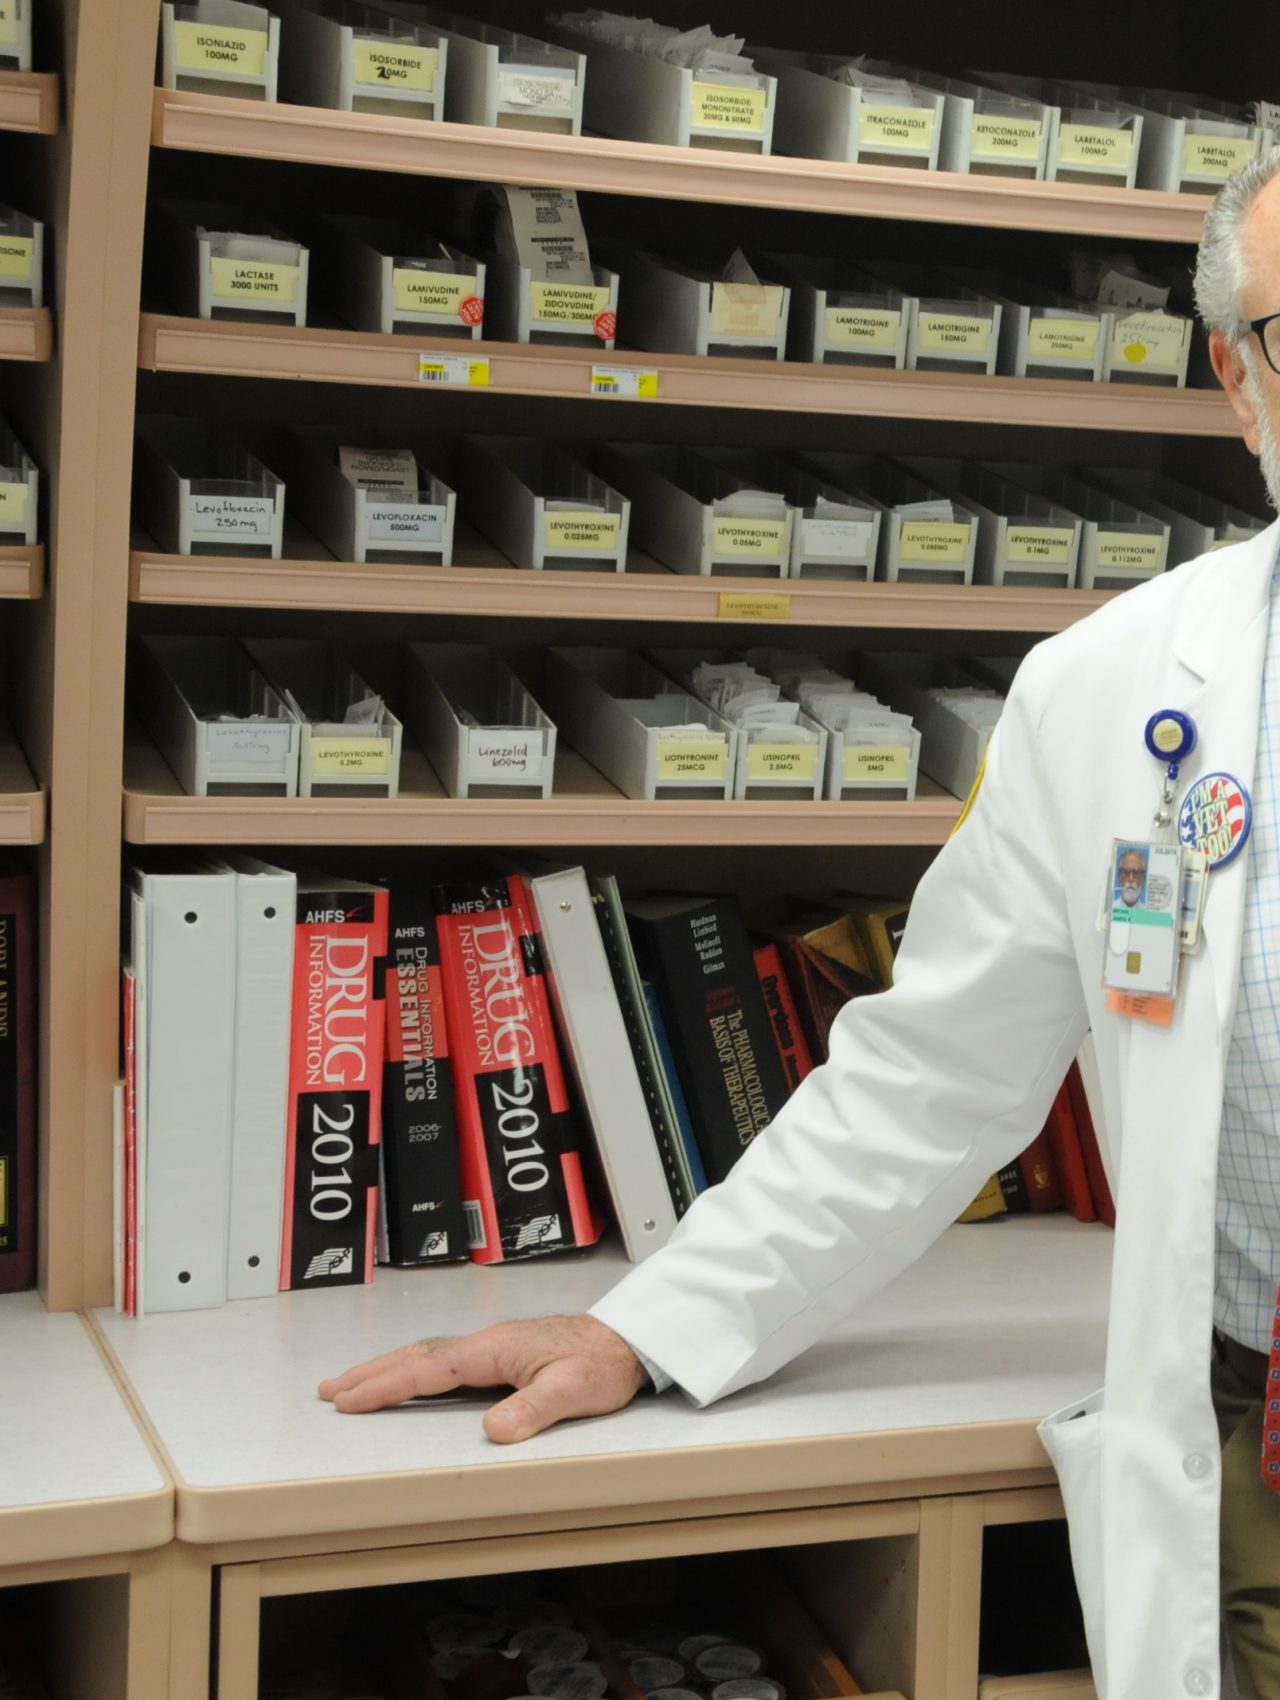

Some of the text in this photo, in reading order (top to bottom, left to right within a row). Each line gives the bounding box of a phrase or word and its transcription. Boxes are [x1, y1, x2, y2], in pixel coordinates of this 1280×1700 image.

[197, 37, 246, 51] ISONIAZID
[204, 50, 239, 62] 100MG
[369, 54, 422, 70] ISOSORBIDE
[706, 95, 751, 106] ISOSORBIDE
[701, 103, 755, 116] MONONITRATE
[866, 115, 926, 129] ITRACONAZOLE
[882, 127, 909, 138] 100MG
[976, 125, 1036, 139] KETOCONAZOLE
[992, 136, 1019, 147] 200MG
[1074, 135, 1115, 147] LABETALOL
[1081, 146, 1107, 156] 100MG
[1197, 146, 1235, 158] LABETALOL
[1202, 157, 1228, 167] 200MG
[235, 269, 275, 281] LACTASE
[230, 280, 279, 292] 3000 UNITS
[407, 284, 460, 296] LAMIVUDINE
[418, 296, 449, 306] 150MG
[542, 289, 597, 301] LAMIVUDINE/
[544, 299, 595, 311] ZIDOVUDINE
[835, 316, 889, 329] LAMOTRIGINE
[928, 323, 980, 334] LAMOTRIGINE
[848, 328, 875, 337] 100MG
[940, 333, 967, 343] 150MG
[1039, 333, 1086, 343] LAMOTRIGINE
[195, 502, 266, 515] Levofloxacin
[372, 512, 437, 522] LEVOFLOXACIN
[390, 523, 420, 532] 500MG
[550, 521, 614, 533] LEVOTHYROXINE
[564, 532, 600, 542] 0.025MG
[717, 528, 779, 539] LEVOTHYROXINE
[907, 535, 963, 544] LEVOTHYROXINE
[732, 538, 762, 547] 0.05MG
[1011, 536, 1068, 547] LEVOTHYROXINE
[1100, 545, 1156, 555] LEVOTHYROXINE
[319, 751, 384, 759] LEVOTHYROXINE
[478, 743, 528, 757] Linezolid
[664, 753, 719, 762] LIOTHYRONINE
[762, 753, 800, 762] LISINOPRIL
[858, 754, 895, 763] LISINOPRIL
[677, 763, 706, 772] 25MCG
[769, 763, 793, 771] 2.5MG
[1193, 799, 1230, 835] VET
[450, 899, 486, 916] AHFS
[305, 909, 346, 924] AHFS
[394, 926, 426, 939] AHFS
[693, 923, 717, 938] Limbird
[702, 961, 725, 975] Gilman
[457, 924, 495, 1067] INFORMATION
[471, 920, 537, 1064] DRUG
[306, 935, 327, 1086] INFORMATION
[323, 934, 369, 1087] DRUG
[395, 947, 426, 1102] ESSENTIALS
[415, 946, 438, 1101] DRUG INFORMATION
[727, 1009, 772, 1134] The PHARMACOLOGICA
[709, 1014, 729, 1048] BASIS
[722, 1067, 755, 1145] THERAPEUTICS
[408, 1132, 440, 1143] 2007
[491, 1079, 550, 1193] 2010
[309, 1103, 356, 1221] 2010
[412, 1201, 436, 1213] AHFS
